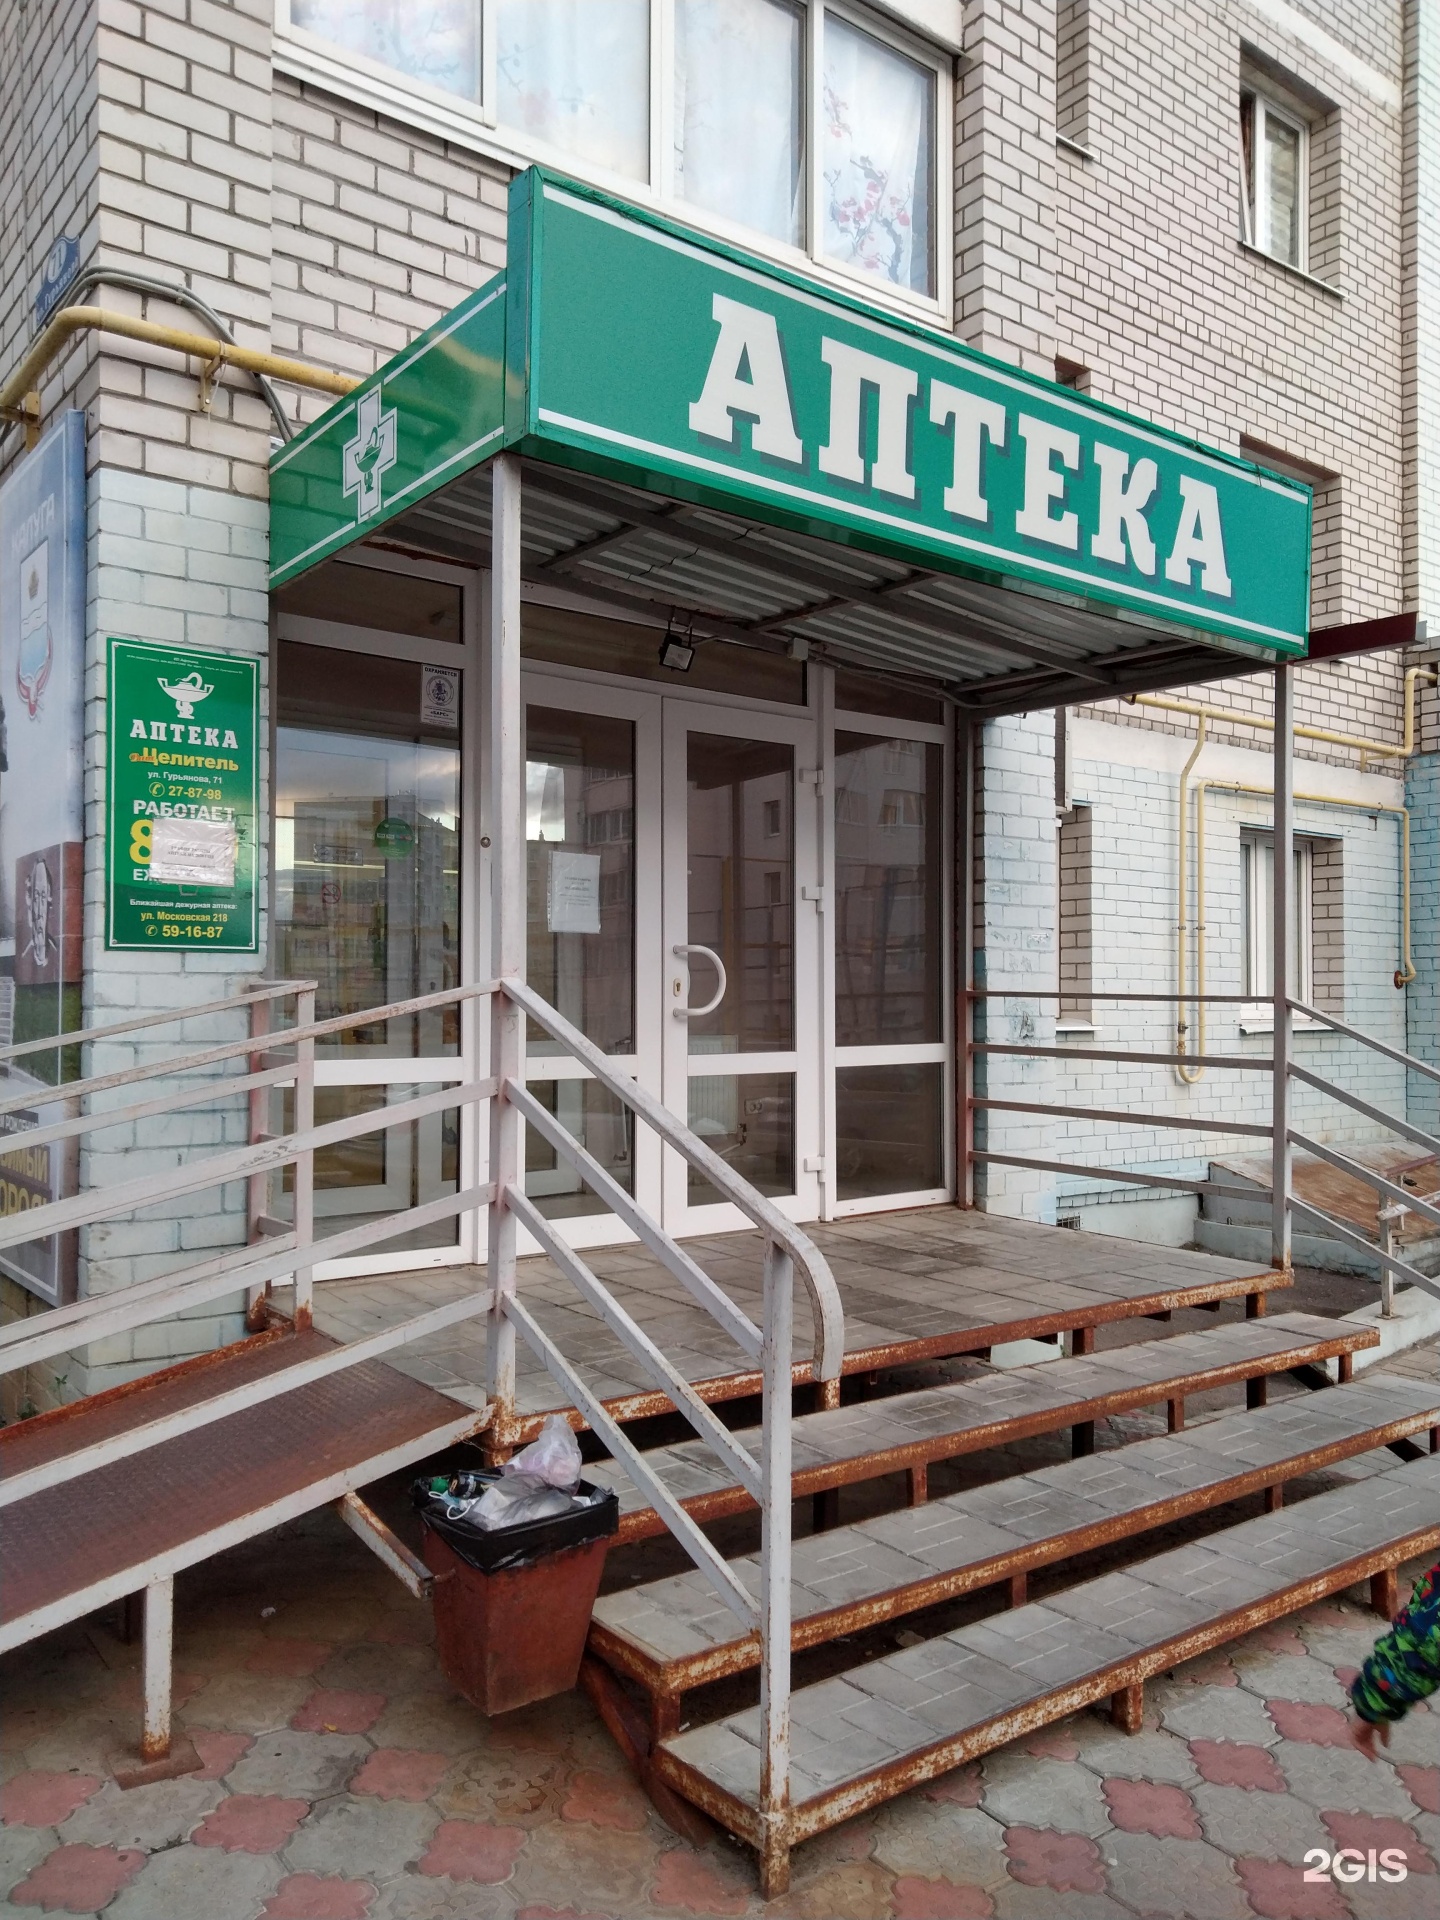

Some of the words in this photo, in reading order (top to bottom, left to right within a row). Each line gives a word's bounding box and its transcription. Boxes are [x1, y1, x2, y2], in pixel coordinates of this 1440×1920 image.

[689, 292, 1234, 599] АПТЕКА
[424, 667, 457, 677] ОХРАНЯЕТСЯ
[130, 719, 239, 749] АПТЕКА
[142, 747, 239, 771] Целитель
[147, 771, 161, 779] ул.
[163, 772, 212, 784] Гурьянова,
[213, 776, 222, 784] 71
[168, 785, 222, 800] 27-87-98
[133, 800, 235, 821] РАБОТАЕТ
[130, 899, 174, 908] Ближайшая
[175, 901, 211, 910] дежурная
[141, 912, 155, 921] ул.
[157, 911, 211, 921] Московская
[212, 913, 228, 922] 218
[162, 925, 224, 938] 59-16-87
